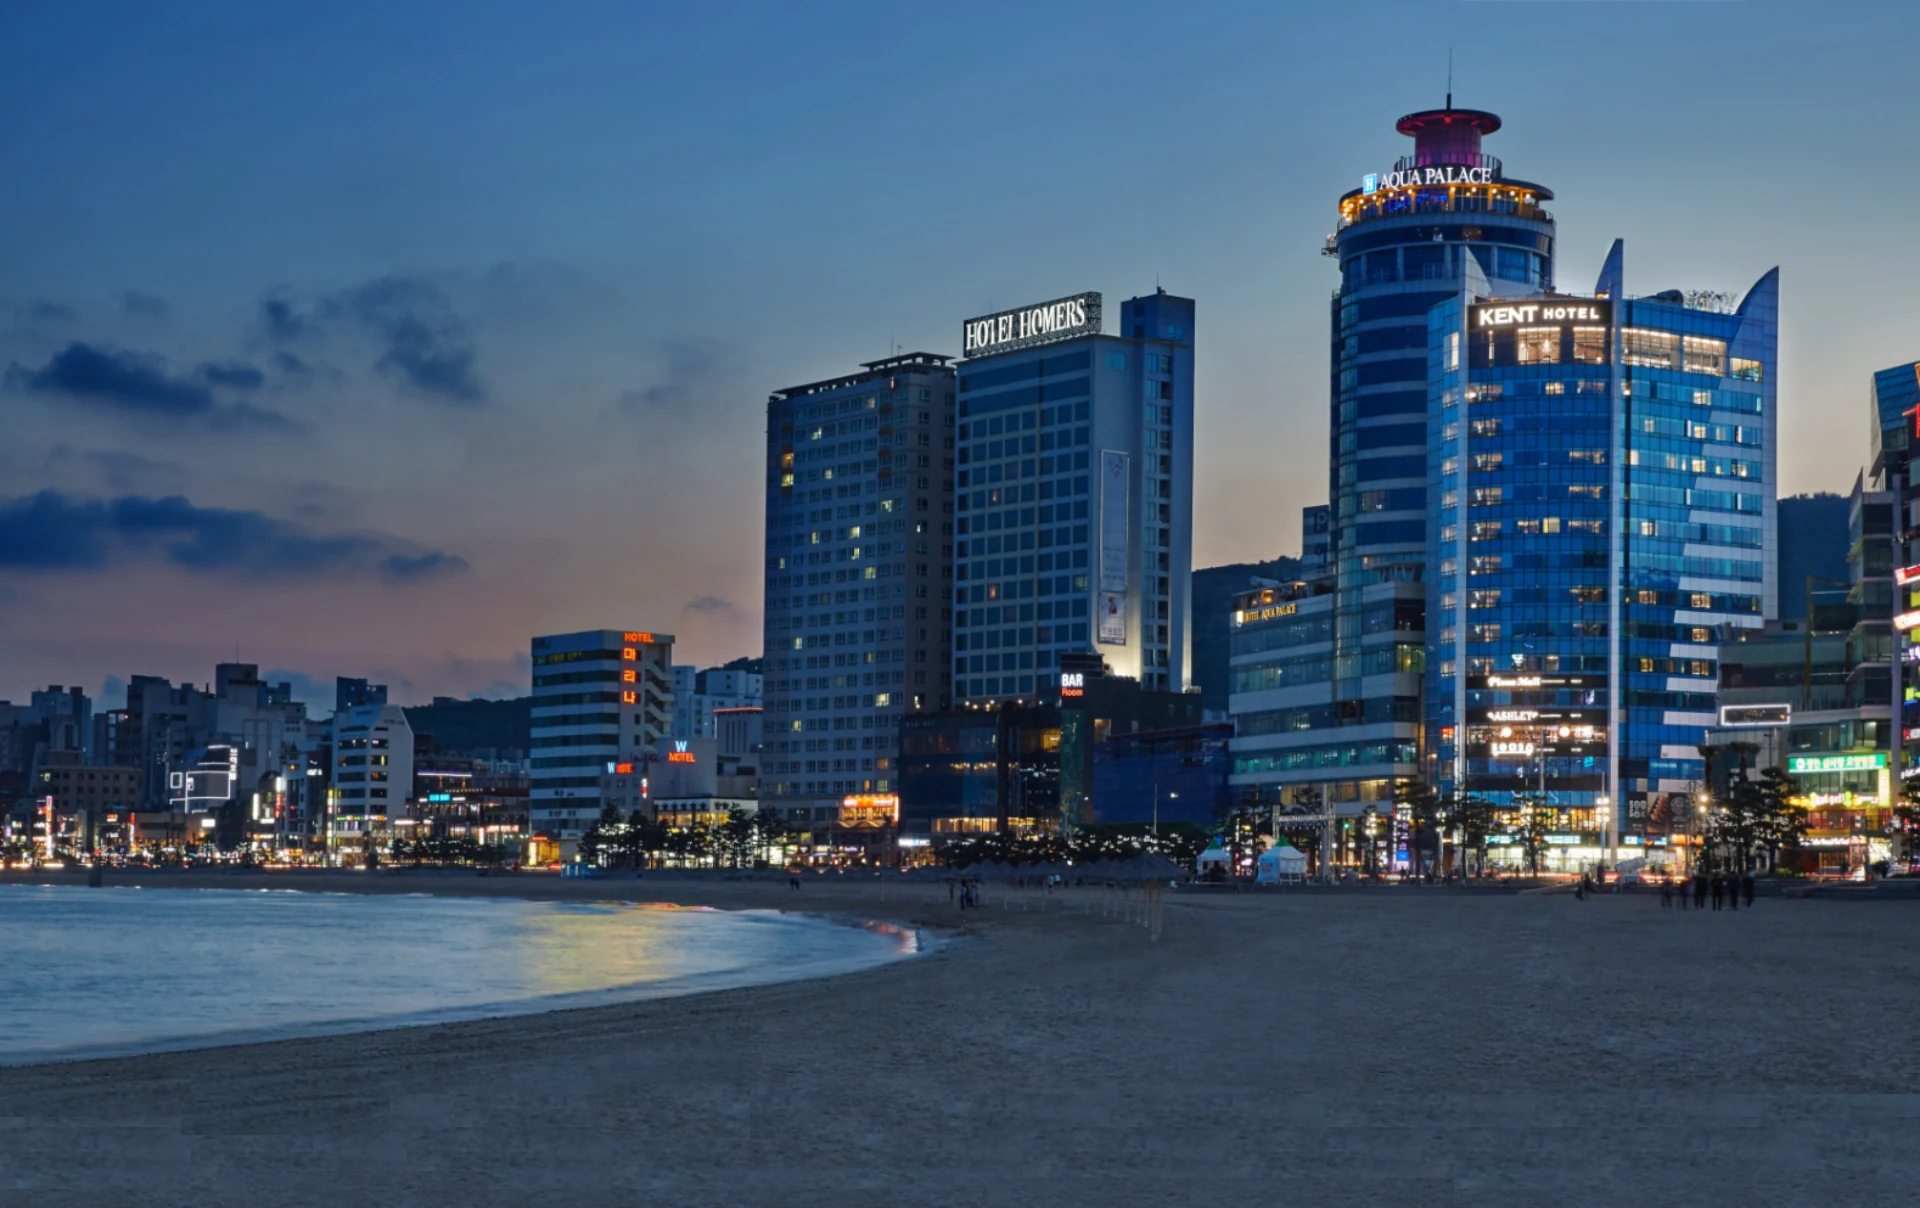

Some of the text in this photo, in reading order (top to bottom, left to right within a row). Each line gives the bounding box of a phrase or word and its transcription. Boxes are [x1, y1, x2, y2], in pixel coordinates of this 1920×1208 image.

[1380, 169, 1422, 191] AQUA
[1425, 166, 1492, 185] PALACE
[1479, 305, 1600, 326] KENT HOTEL
[966, 298, 1086, 350] HOTEL HOMERS
[624, 632, 654, 643] HOTEL
[1061, 673, 1083, 687] BAR
[1493, 711, 1533, 721] ASHLEY
[675, 740, 687, 752] W
[669, 752, 696, 763] MOTEL
[607, 762, 616, 774] W
